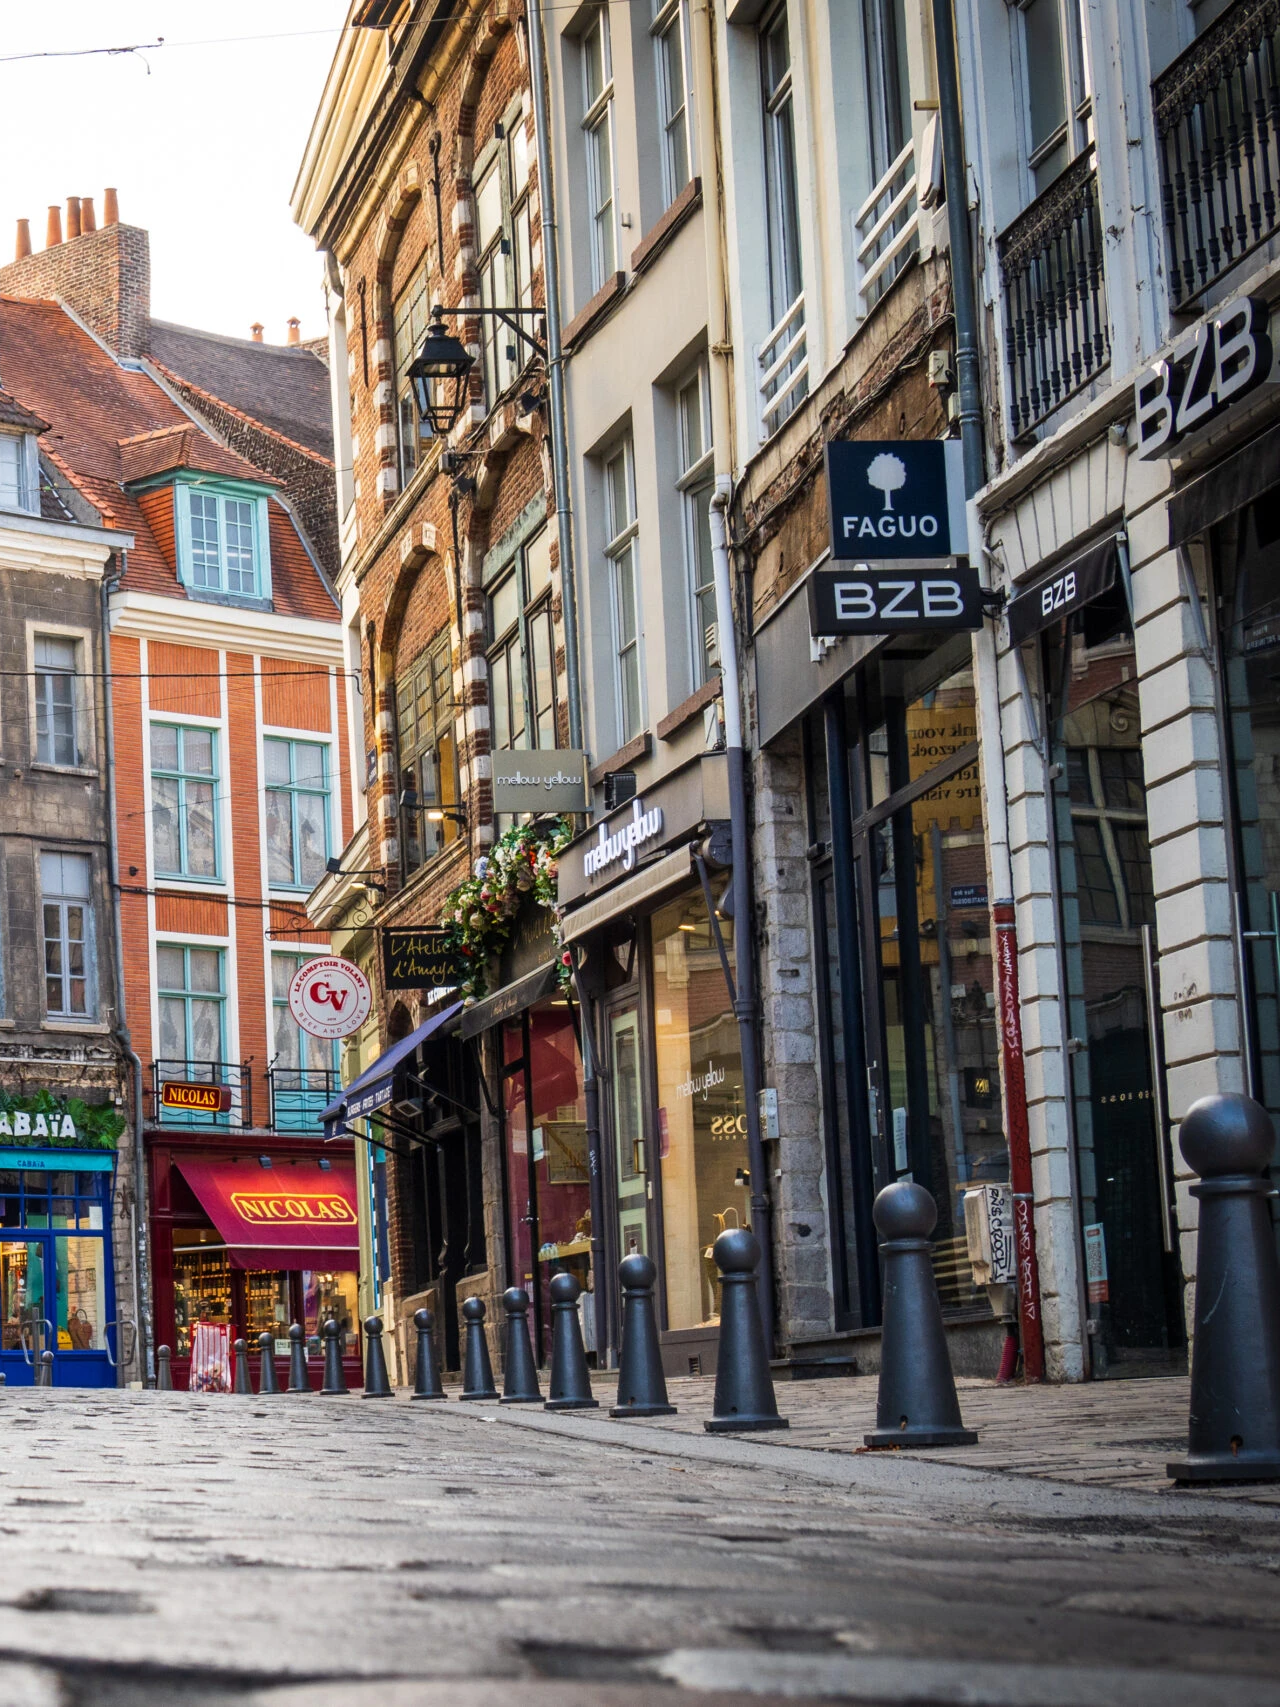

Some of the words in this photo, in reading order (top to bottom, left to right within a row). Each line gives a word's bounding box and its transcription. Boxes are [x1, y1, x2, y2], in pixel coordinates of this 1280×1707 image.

[1134, 296, 1268, 460] BZB
[842, 515, 938, 538] FAGUO
[833, 580, 964, 620] BZB
[1041, 571, 1076, 616] BZB
[497, 771, 540, 787] mellow
[543, 771, 582, 791] yellow
[583, 823, 622, 878] mellow
[621, 799, 664, 872] yellow
[294, 981, 302, 993] LE
[298, 960, 339, 982] COMPTOIR
[340, 963, 366, 989] VOLANT
[392, 958, 458, 985] d'Amaya
[309, 981, 348, 1012] CV
[298, 1011, 318, 1029] BEEF
[347, 1009, 365, 1029] LOVE
[168, 1087, 216, 1106] NICOLAS
[676, 1070, 701, 1100] mellow
[701, 1060, 725, 1102] yellow
[238, 1199, 350, 1219] NICOLAS
